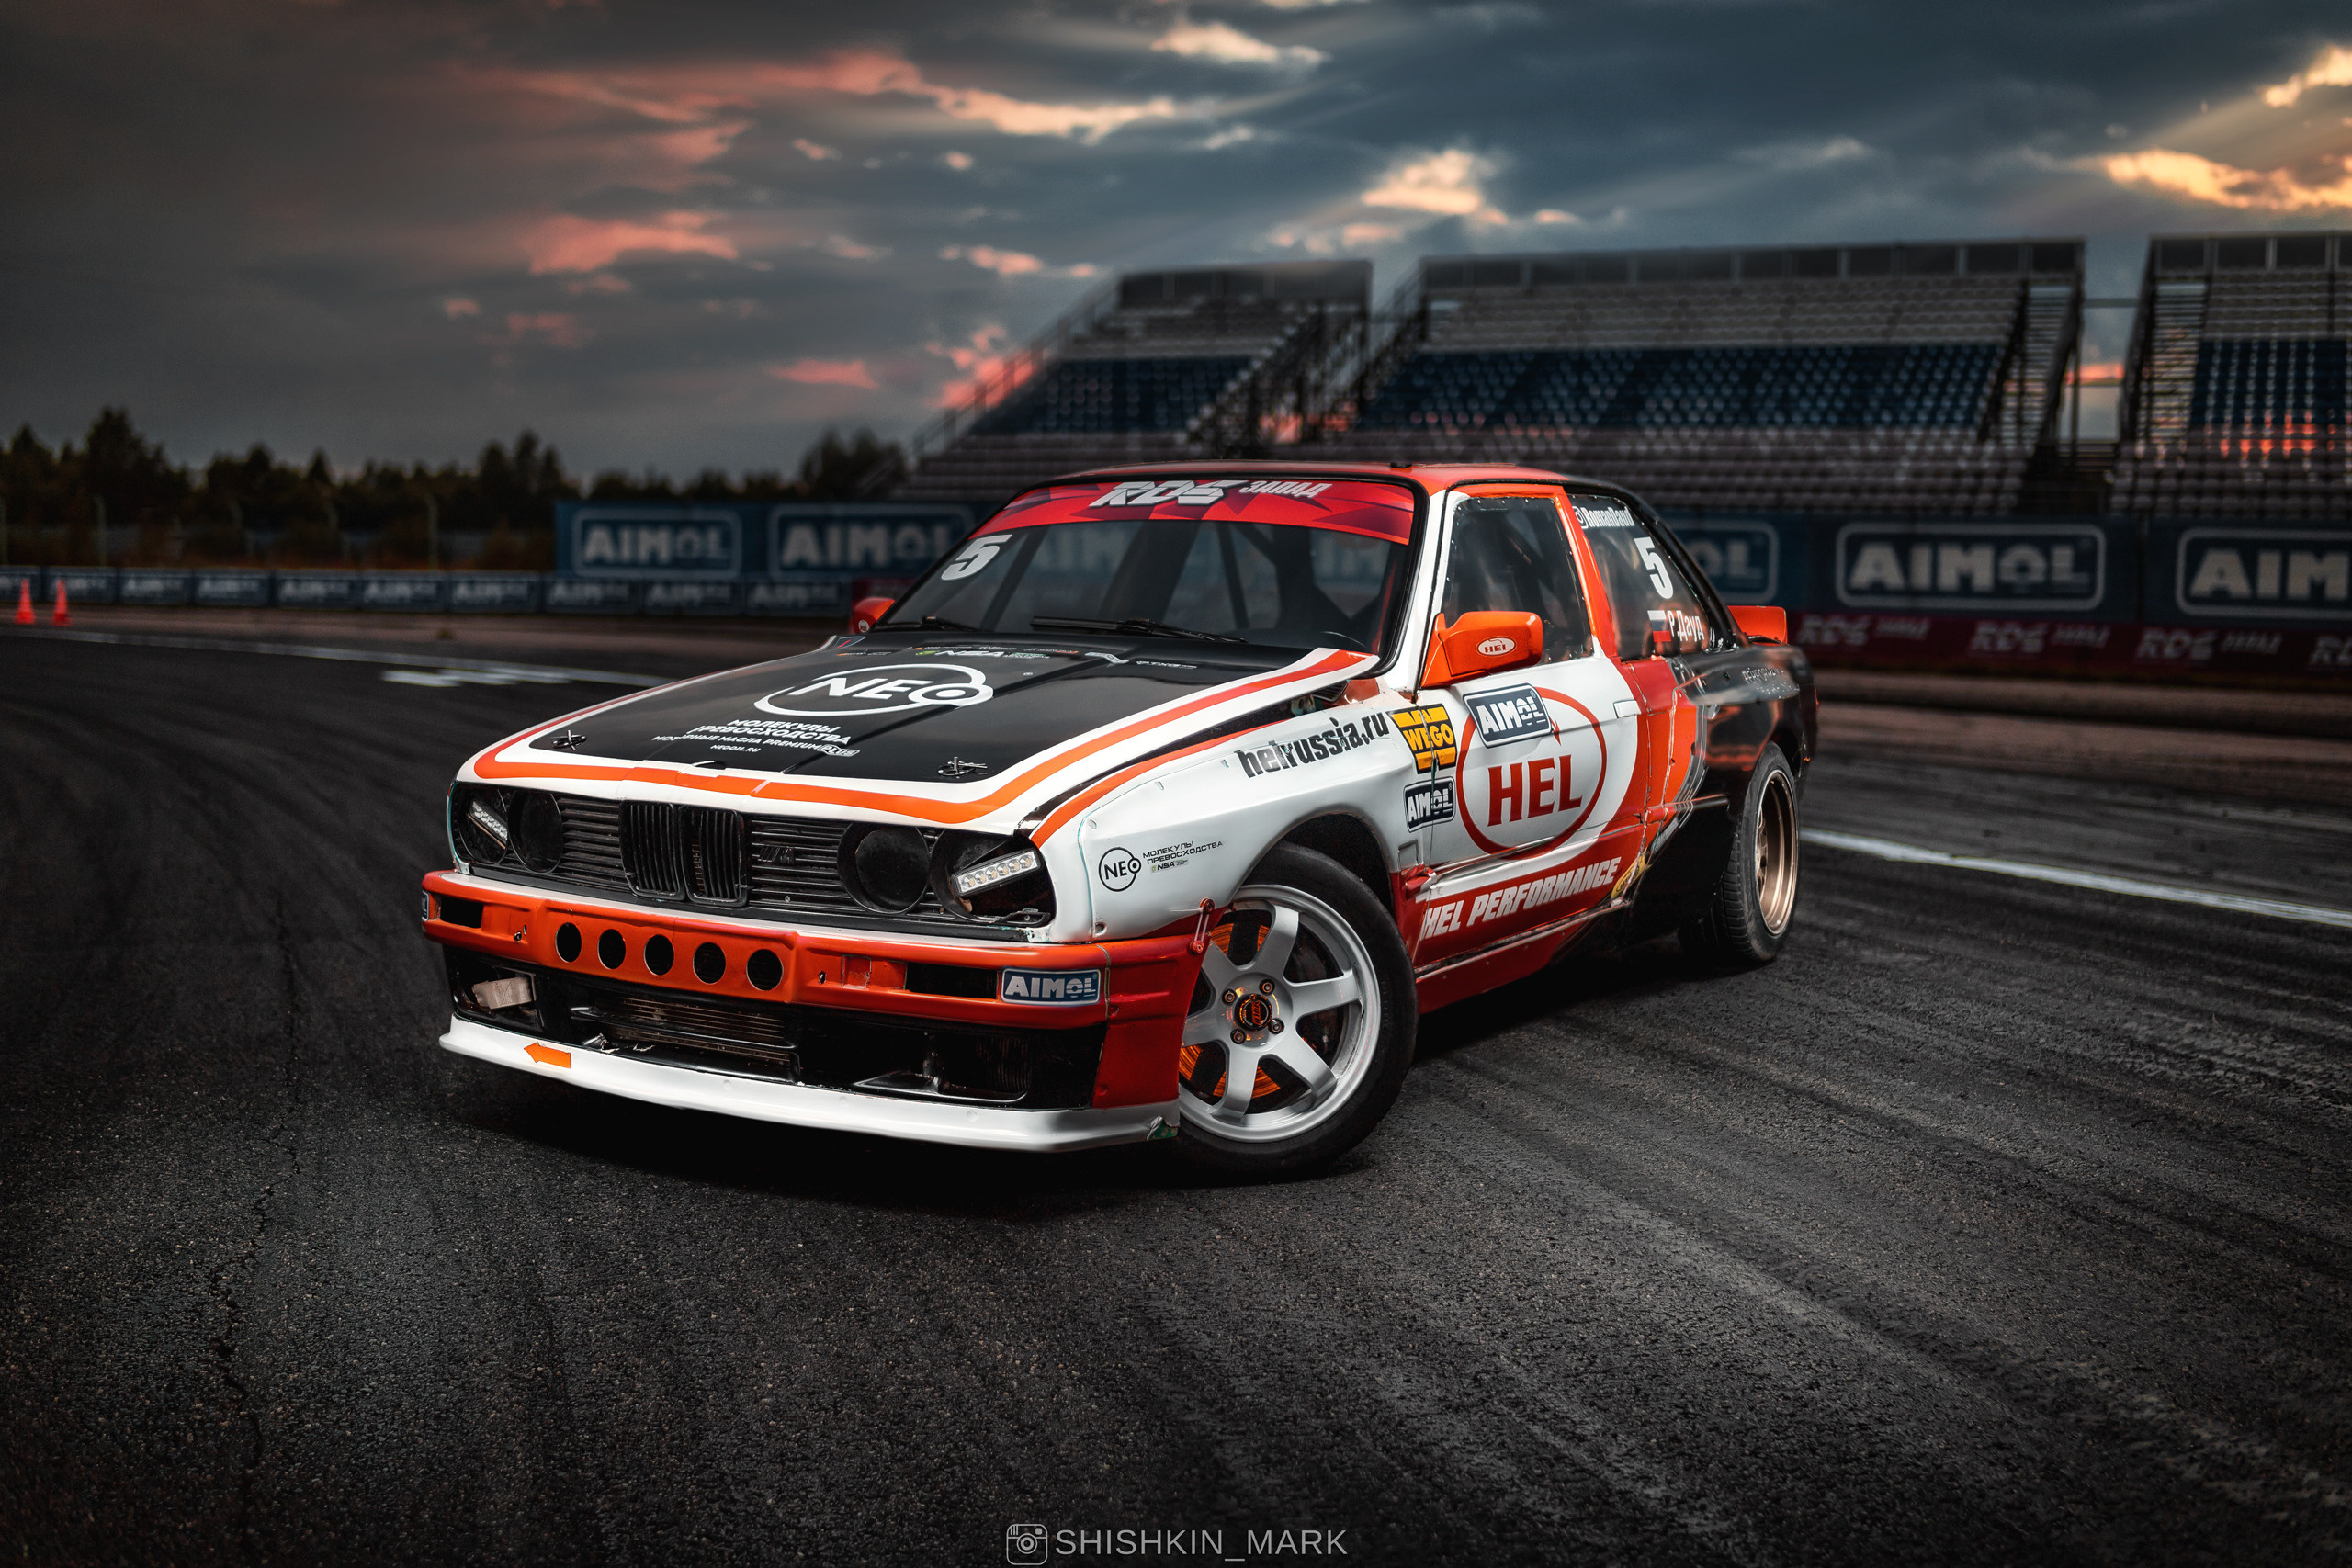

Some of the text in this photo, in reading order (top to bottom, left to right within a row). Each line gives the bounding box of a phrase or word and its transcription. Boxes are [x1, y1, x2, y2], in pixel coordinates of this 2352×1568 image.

[1089, 480, 1249, 507] RDS
[583, 524, 728, 564] AIMOL
[941, 534, 1012, 581] 5
[1634, 536, 1674, 599] 5
[1848, 541, 2090, 592] AIMOL
[1484, 643, 1510, 653] HEL
[786, 678, 993, 707] NEO
[726, 719, 841, 733] МОЛЕКУЛЫ
[1478, 694, 1546, 735] AIMOL
[1234, 713, 1390, 778] helrussia.ru
[1403, 722, 1454, 751] WEGO
[1407, 787, 1453, 823] AIMOL
[1487, 754, 1583, 827] HEL
[1143, 841, 1194, 859] МОЛЕКУЛЫ
[1147, 840, 1224, 864] ПРЕВОСХОДСТВА
[1104, 857, 1142, 881] NEO
[1158, 861, 1175, 870] NSA
[1419, 900, 1464, 941] HEL
[1467, 856, 1622, 927] PERFORMANCE
[1004, 976, 1097, 998] AIMOL
